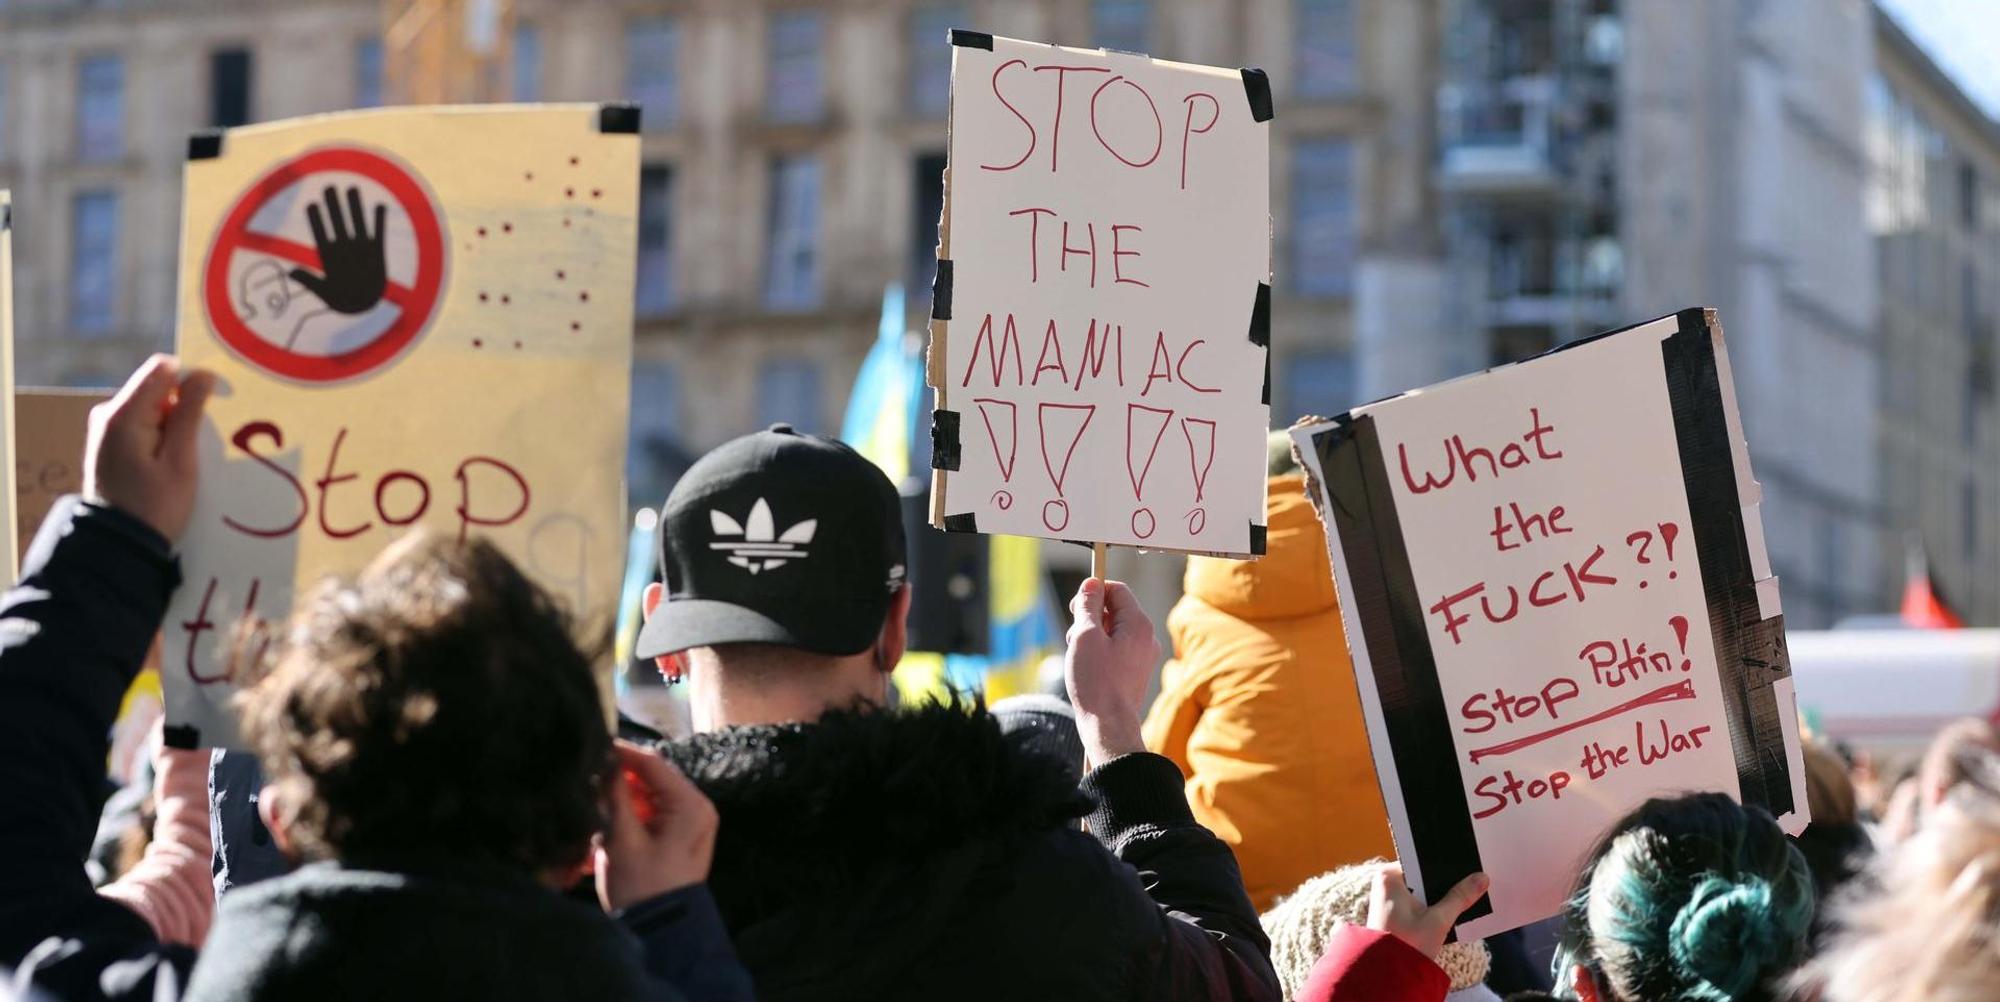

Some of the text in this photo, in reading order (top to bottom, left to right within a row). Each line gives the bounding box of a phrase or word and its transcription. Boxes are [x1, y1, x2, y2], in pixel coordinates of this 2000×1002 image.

[979, 58, 1220, 190] STOP
[1008, 207, 1150, 289] THE
[962, 313, 1222, 397] MANIAC
[222, 420, 531, 545] Stop
[1398, 407, 1563, 495] What
[1489, 502, 1574, 552] the
[182, 576, 272, 684] th
[1460, 615, 1692, 734] Stop Putin!
[1472, 718, 1712, 820] Stop the War
